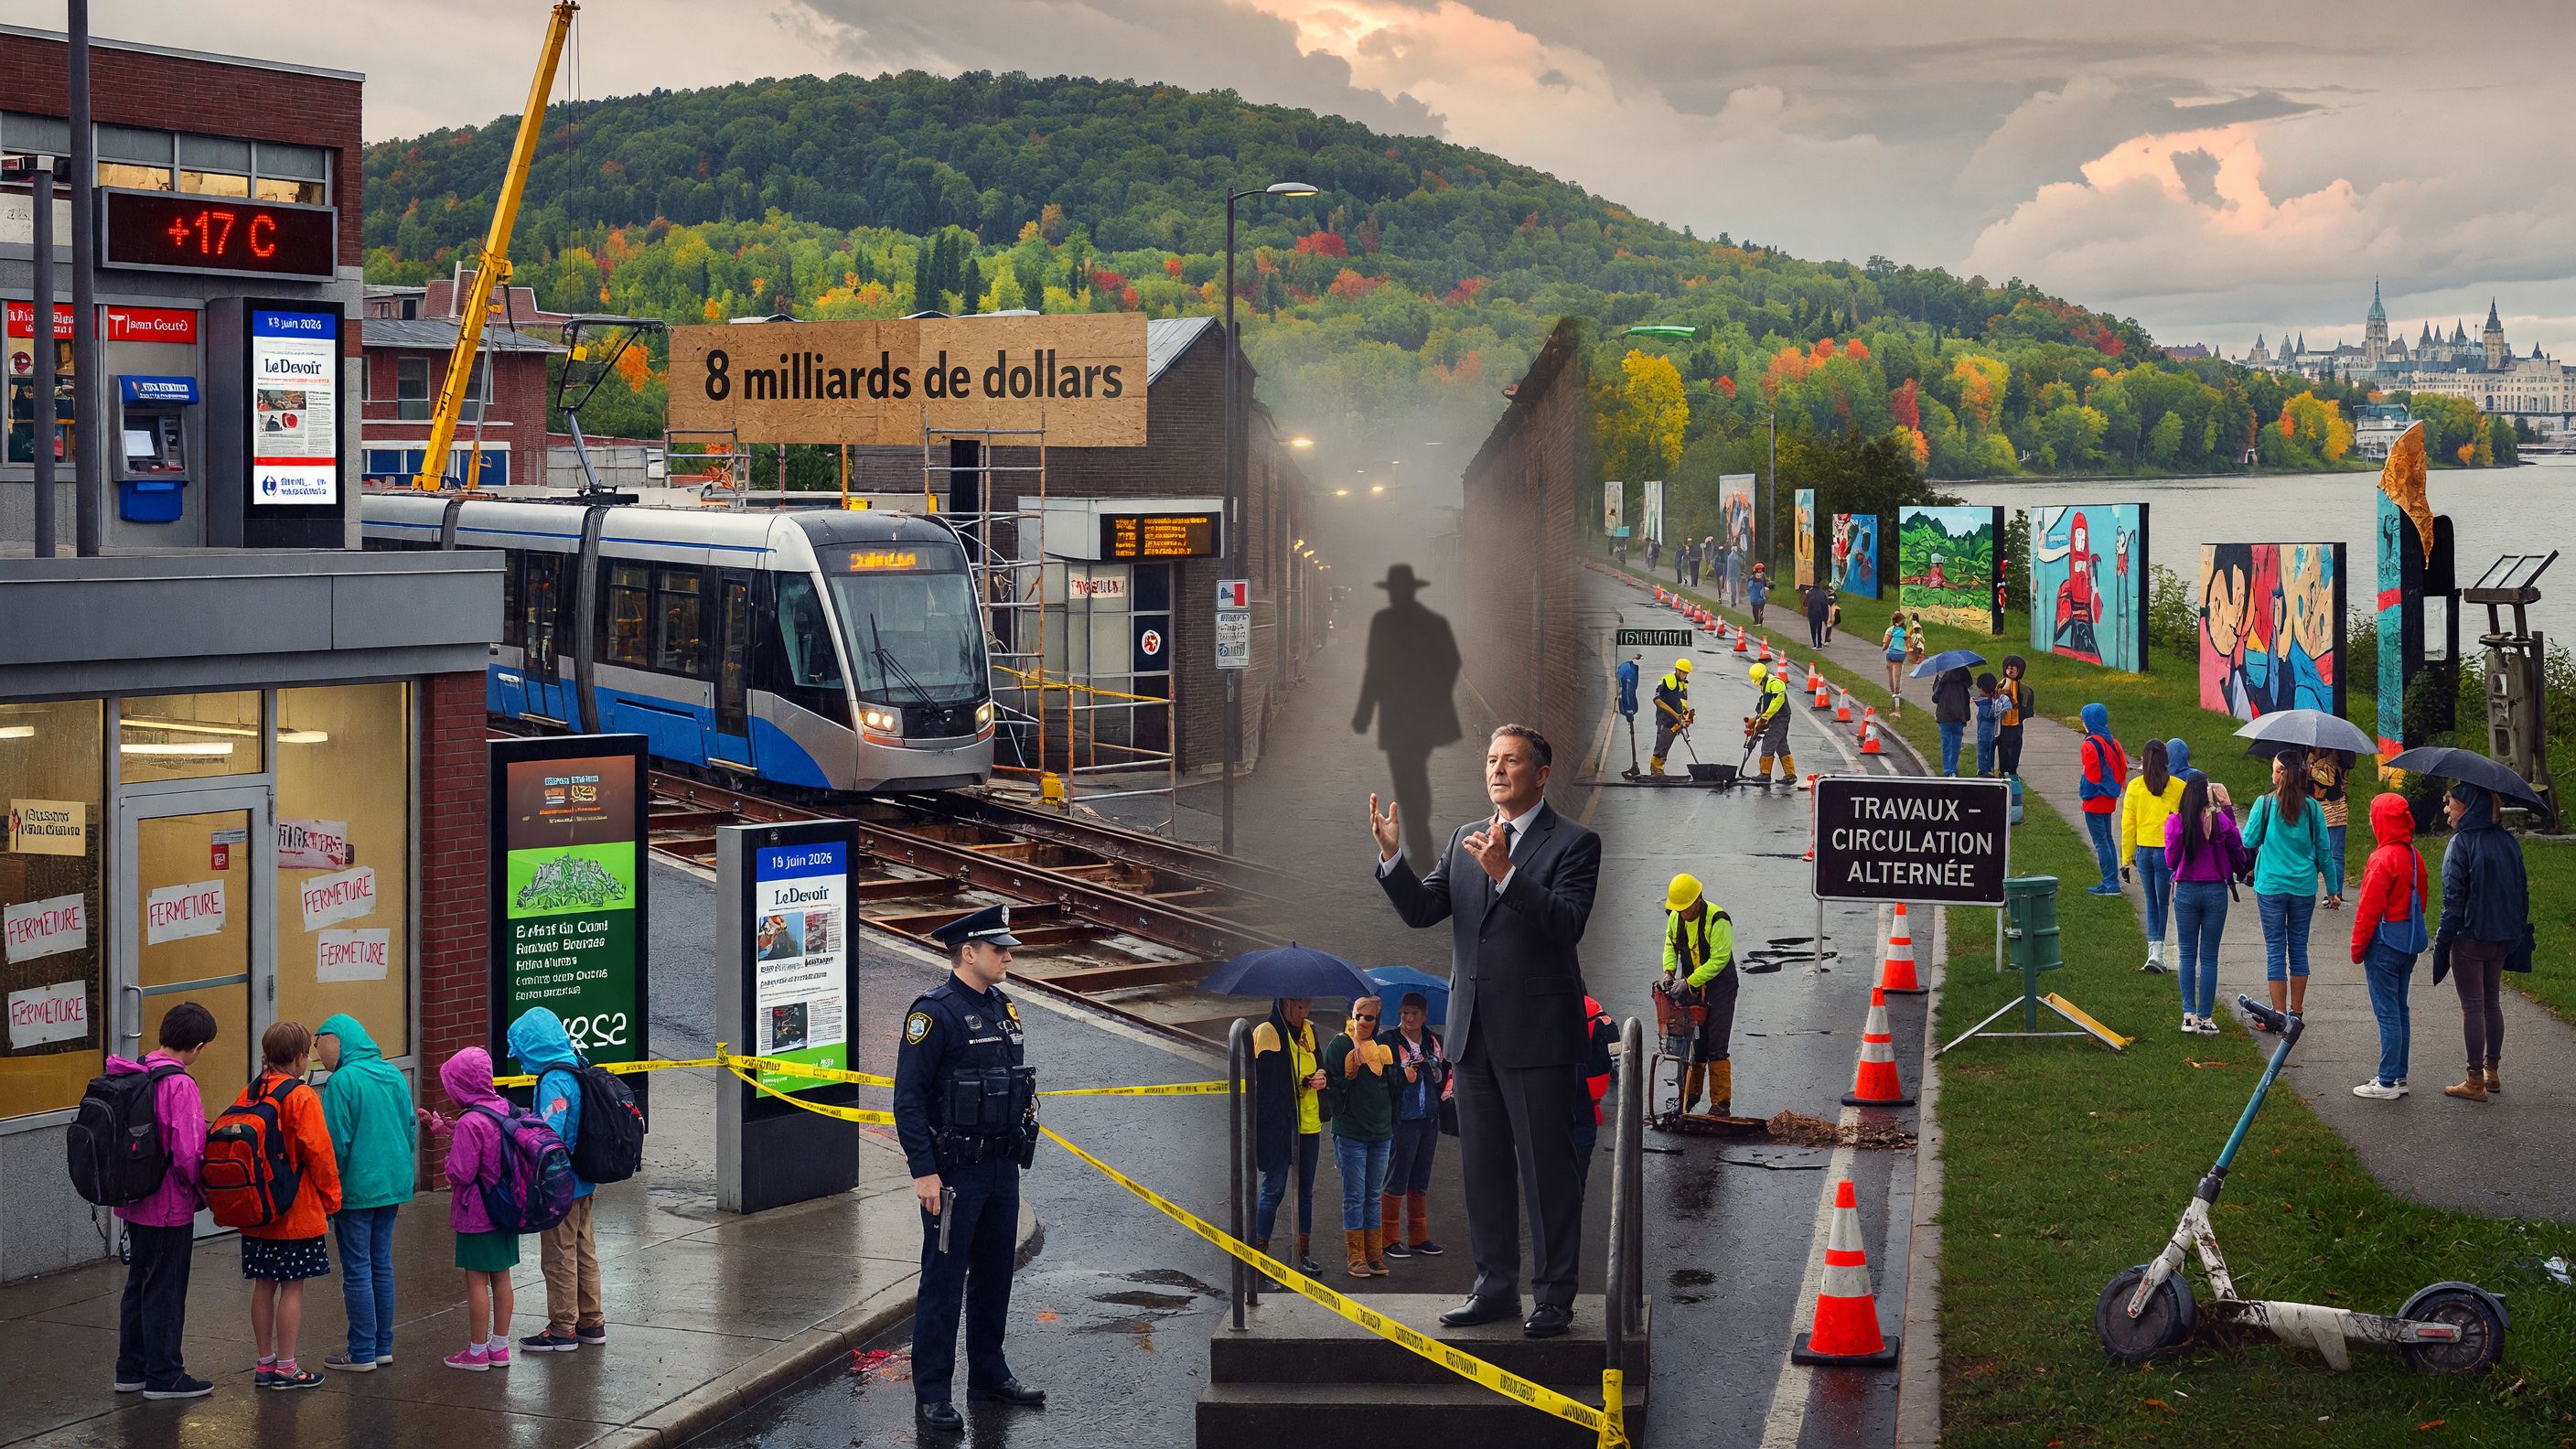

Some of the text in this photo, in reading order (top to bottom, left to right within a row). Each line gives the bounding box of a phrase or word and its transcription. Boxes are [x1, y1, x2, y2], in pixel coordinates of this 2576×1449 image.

[169, 211, 275, 257] +17 C
[705, 349, 1123, 402] 8 milliards de dollars
[1850, 797, 1960, 821] TRAVAUX
[1831, 828, 1993, 855] CIRCULATION
[785, 854, 806, 870] juin
[808, 853, 832, 865] 2026
[1847, 858, 1975, 887] ALTERNÉE
[149, 890, 222, 928] FERMETURE
[304, 874, 373, 915] FERMETURE
[320, 940, 386, 967] FERMETURE
[12, 996, 84, 1026] FERMETURE
